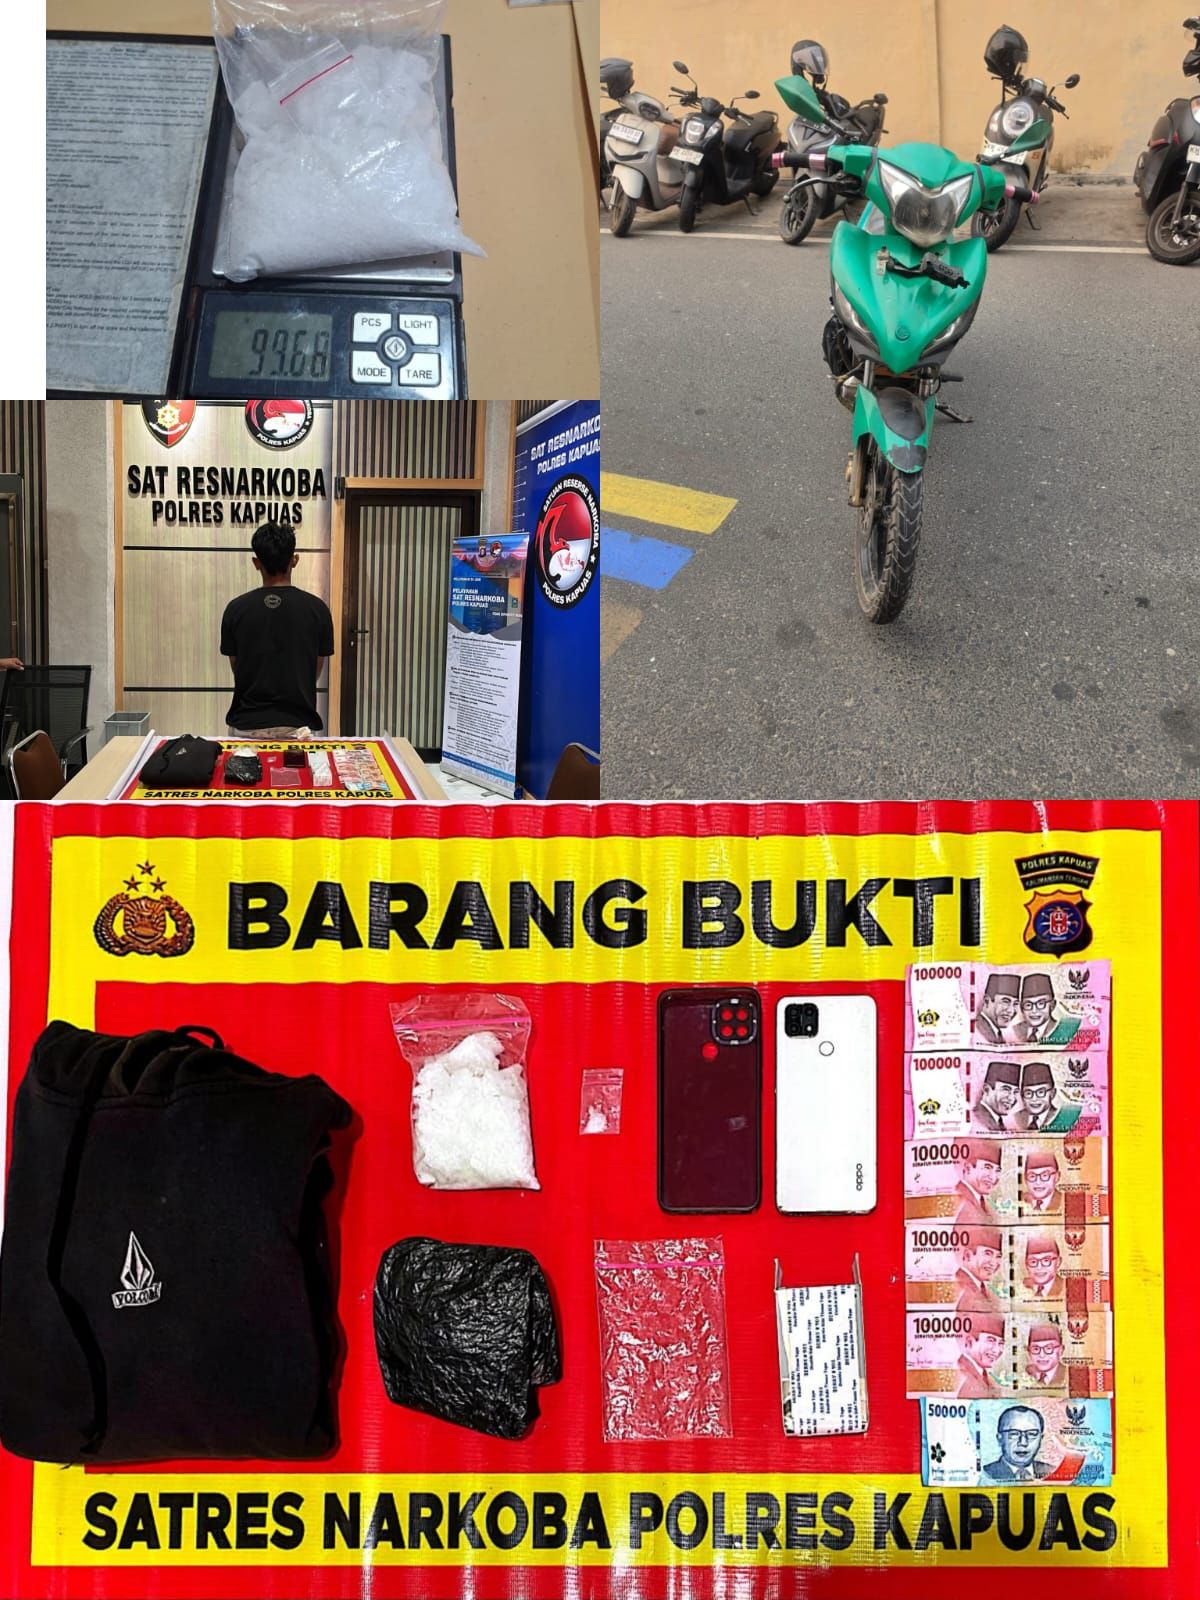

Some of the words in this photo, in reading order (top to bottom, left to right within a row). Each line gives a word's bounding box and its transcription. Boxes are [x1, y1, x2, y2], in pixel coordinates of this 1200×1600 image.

[361, 318, 382, 327] PCS
[403, 320, 433, 329] LIGHT
[357, 367, 387, 377] MODE
[406, 369, 433, 379] TARE
[530, 442, 546, 461] SAT
[537, 452, 567, 475] POLRES
[568, 438, 600, 463] KAPUA
[127, 465, 168, 495] SAT
[177, 466, 326, 498] RESNARKOBA
[152, 500, 224, 524] POLRES
[230, 502, 303, 525] KAPUAS
[543, 482, 562, 513] SATUAN
[563, 478, 590, 496] RESERSE
[586, 494, 599, 549] NARKOBA
[542, 581, 565, 604] POLRES
[566, 570, 592, 604] KAPUAS
[464, 594, 505, 603] RESNARKOBA
[335, 790, 394, 798] KAPUAS
[1022, 856, 1056, 870] POLRES
[1058, 856, 1092, 869] KAPUAS
[228, 879, 648, 951] BARANG
[682, 876, 982, 949] BUKTI
[914, 966, 962, 981] 100000
[913, 1056, 961, 1071] 100000
[912, 1144, 970, 1162] 100000
[912, 1230, 970, 1246] 100000
[913, 1318, 972, 1334] 100000
[928, 1404, 966, 1418] 50000
[82, 1491, 306, 1551] SATRES
[324, 1490, 611, 1550] NARKOBA
[628, 1490, 856, 1551] POLRES
[872, 1491, 1118, 1552] KAPUAS
